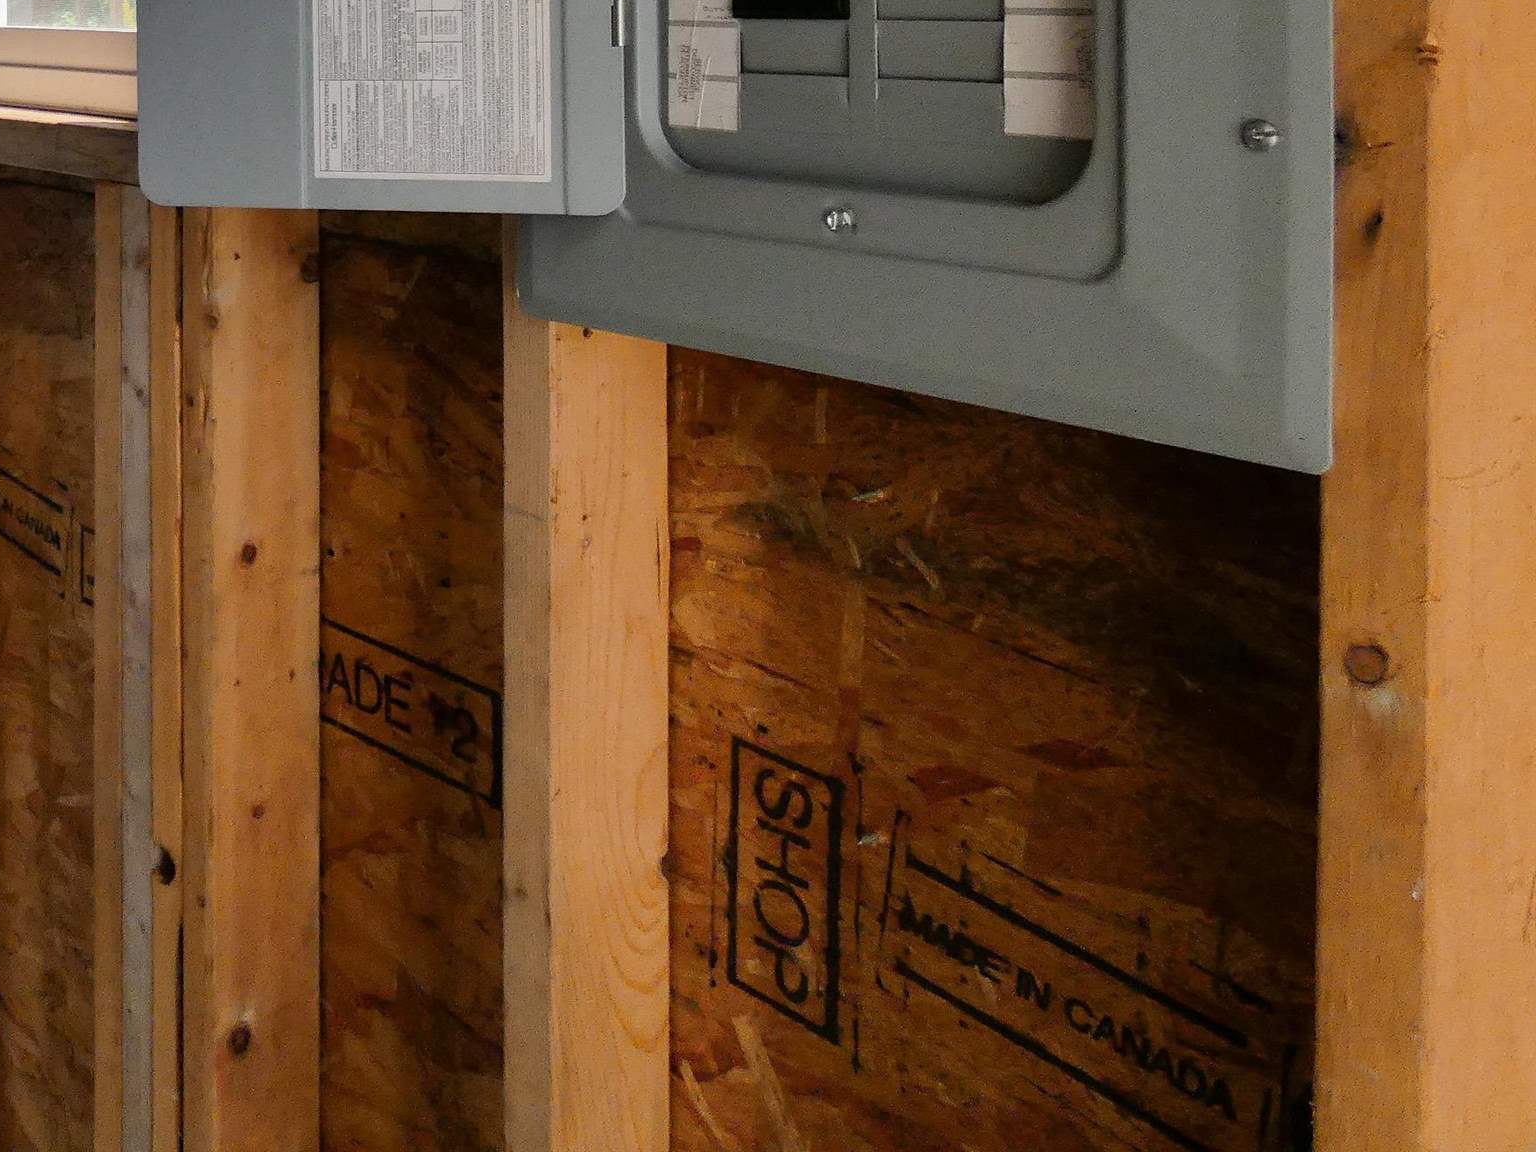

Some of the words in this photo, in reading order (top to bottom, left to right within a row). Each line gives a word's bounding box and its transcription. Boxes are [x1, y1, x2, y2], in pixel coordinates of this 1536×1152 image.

[753, 766, 814, 1005] SHOP
[899, 896, 1013, 983] MADE
[1015, 962, 1052, 1009] IN
[1064, 993, 1237, 1118] CANADA
